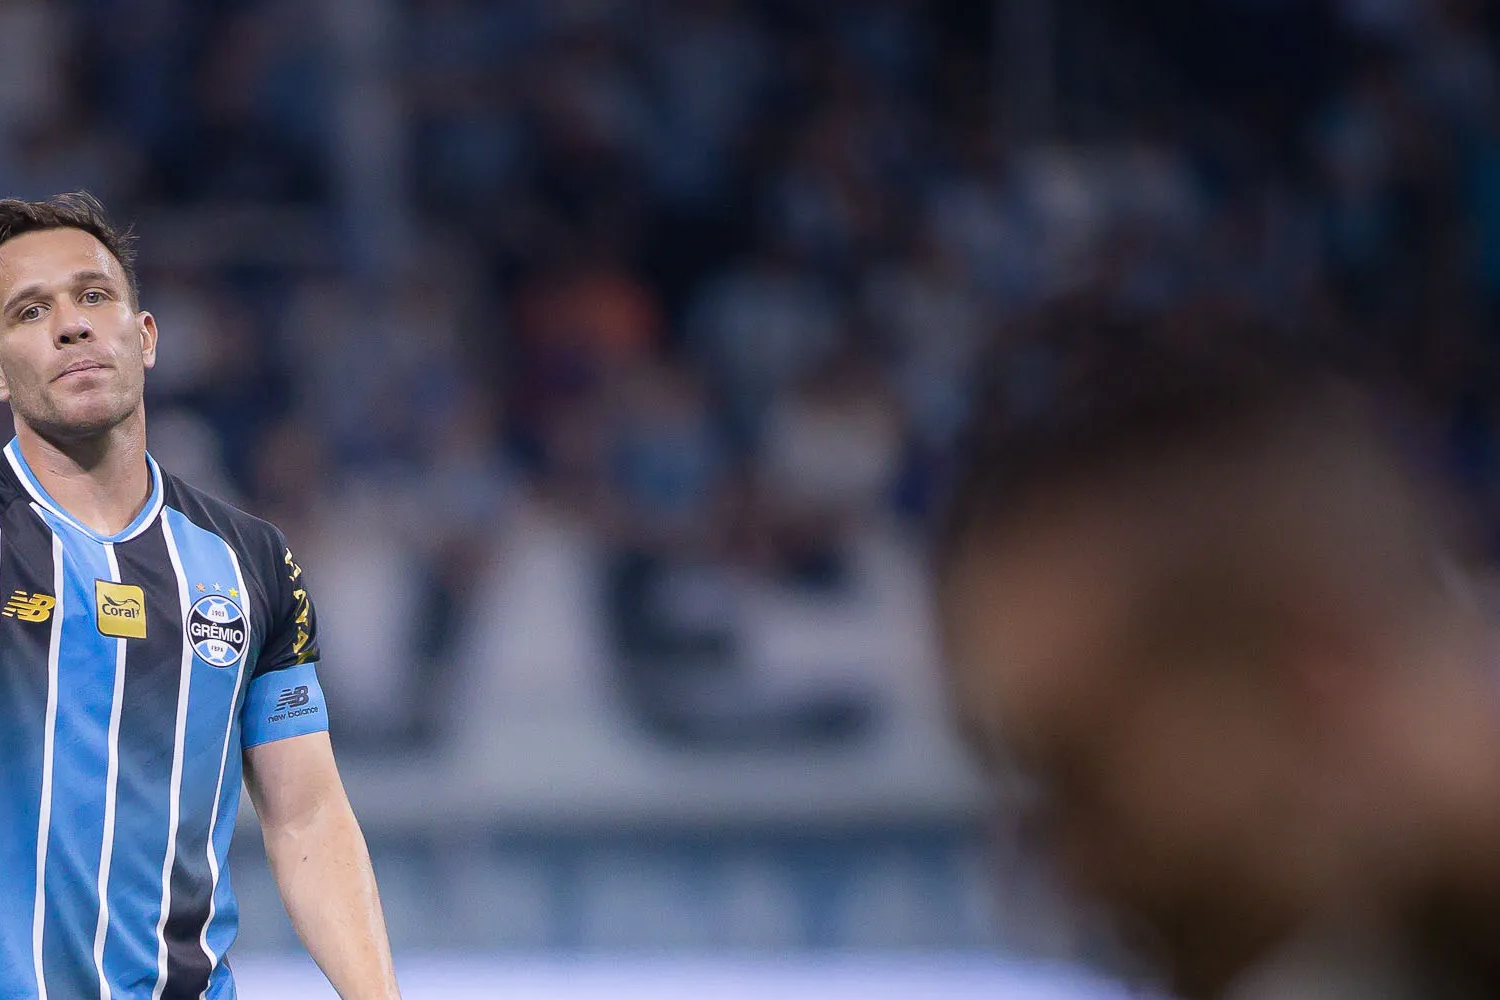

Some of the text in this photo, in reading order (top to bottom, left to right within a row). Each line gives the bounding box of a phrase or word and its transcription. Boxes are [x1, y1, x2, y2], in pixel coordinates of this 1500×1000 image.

[102, 602, 135, 619] Coral
[191, 623, 243, 644] GRÊMIO
[268, 706, 319, 723] new balance
